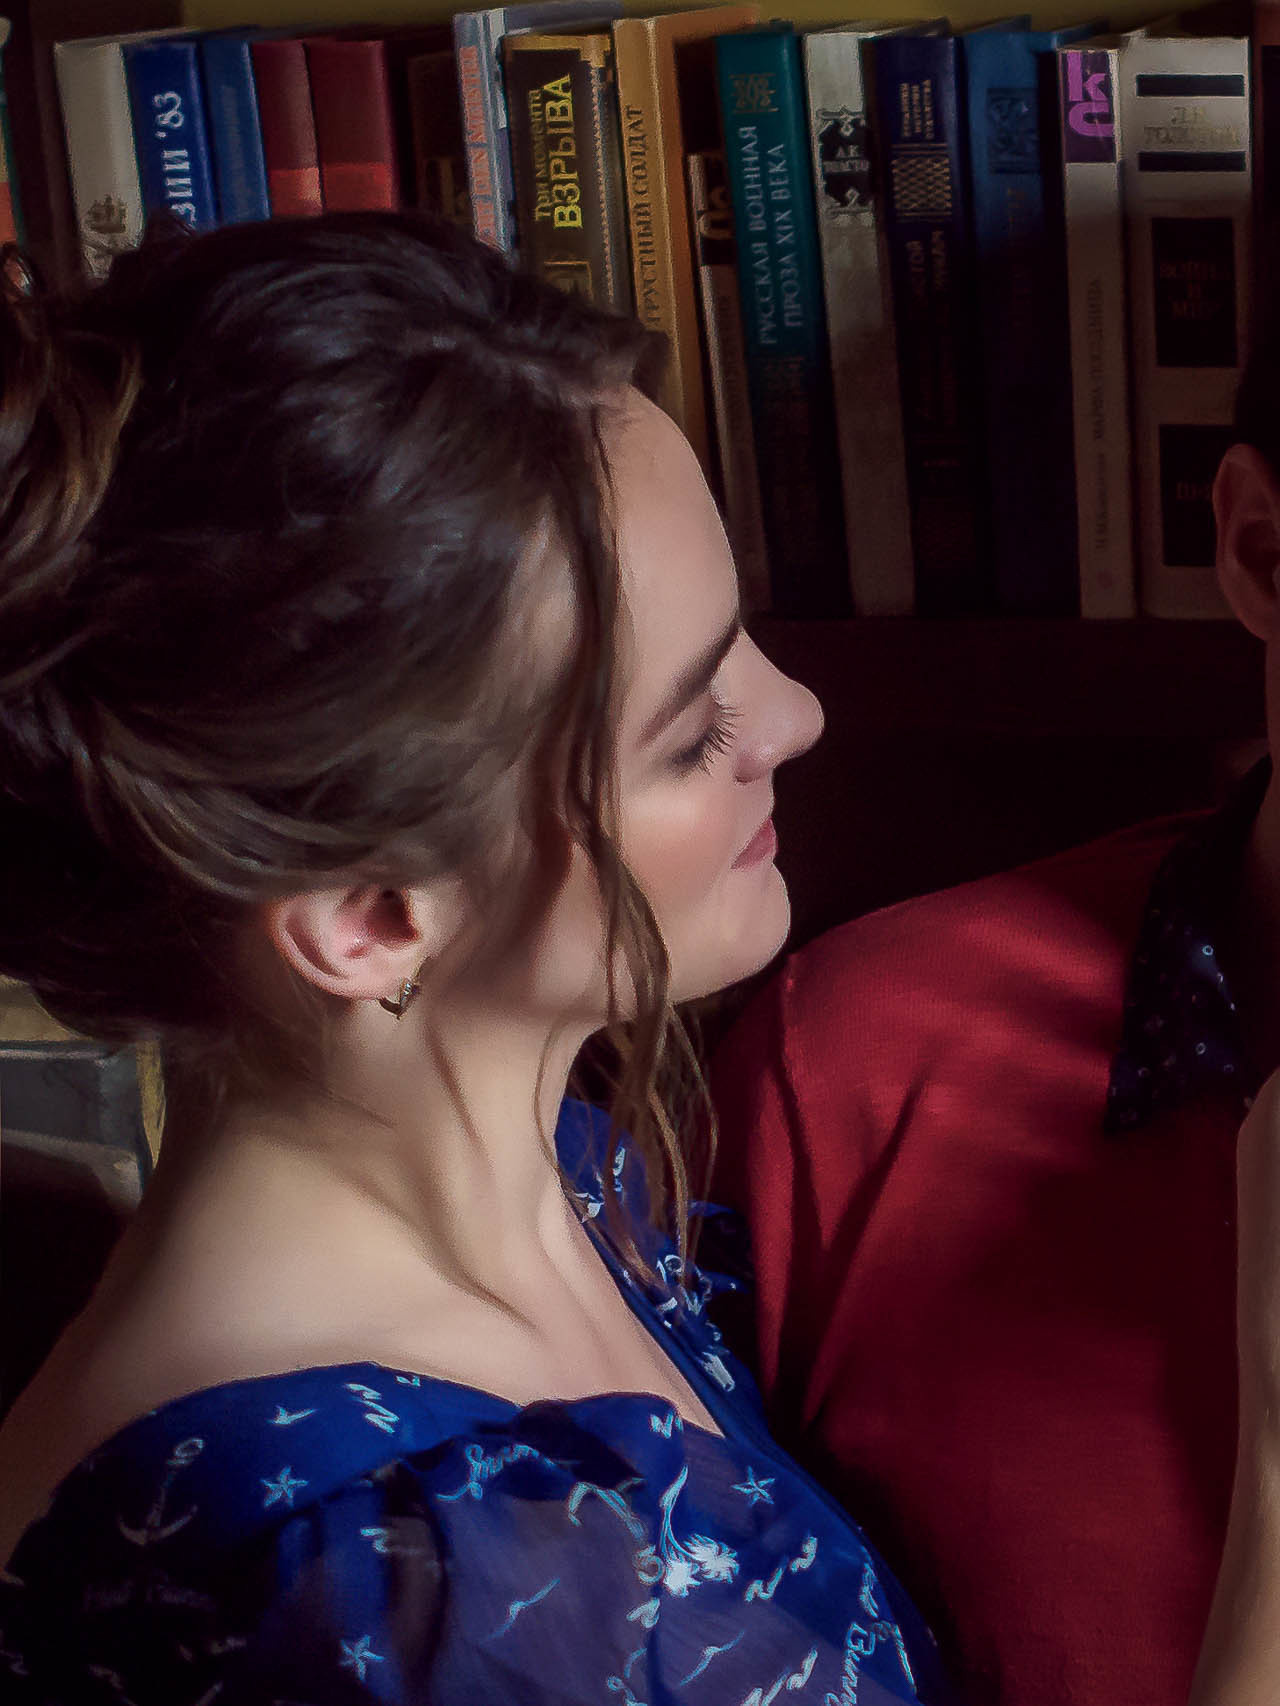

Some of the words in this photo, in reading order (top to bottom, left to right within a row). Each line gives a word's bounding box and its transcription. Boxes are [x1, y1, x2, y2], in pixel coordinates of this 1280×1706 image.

[543, 73, 585, 230] ВЗРЫВА
[624, 105, 650, 196] СОЛДАТ
[738, 125, 765, 232] ВОЕННАЯ
[766, 143, 793, 201] ВЕКА
[749, 240, 777, 345] РУССКАЯ
[778, 253, 803, 329] ПРОЗА
